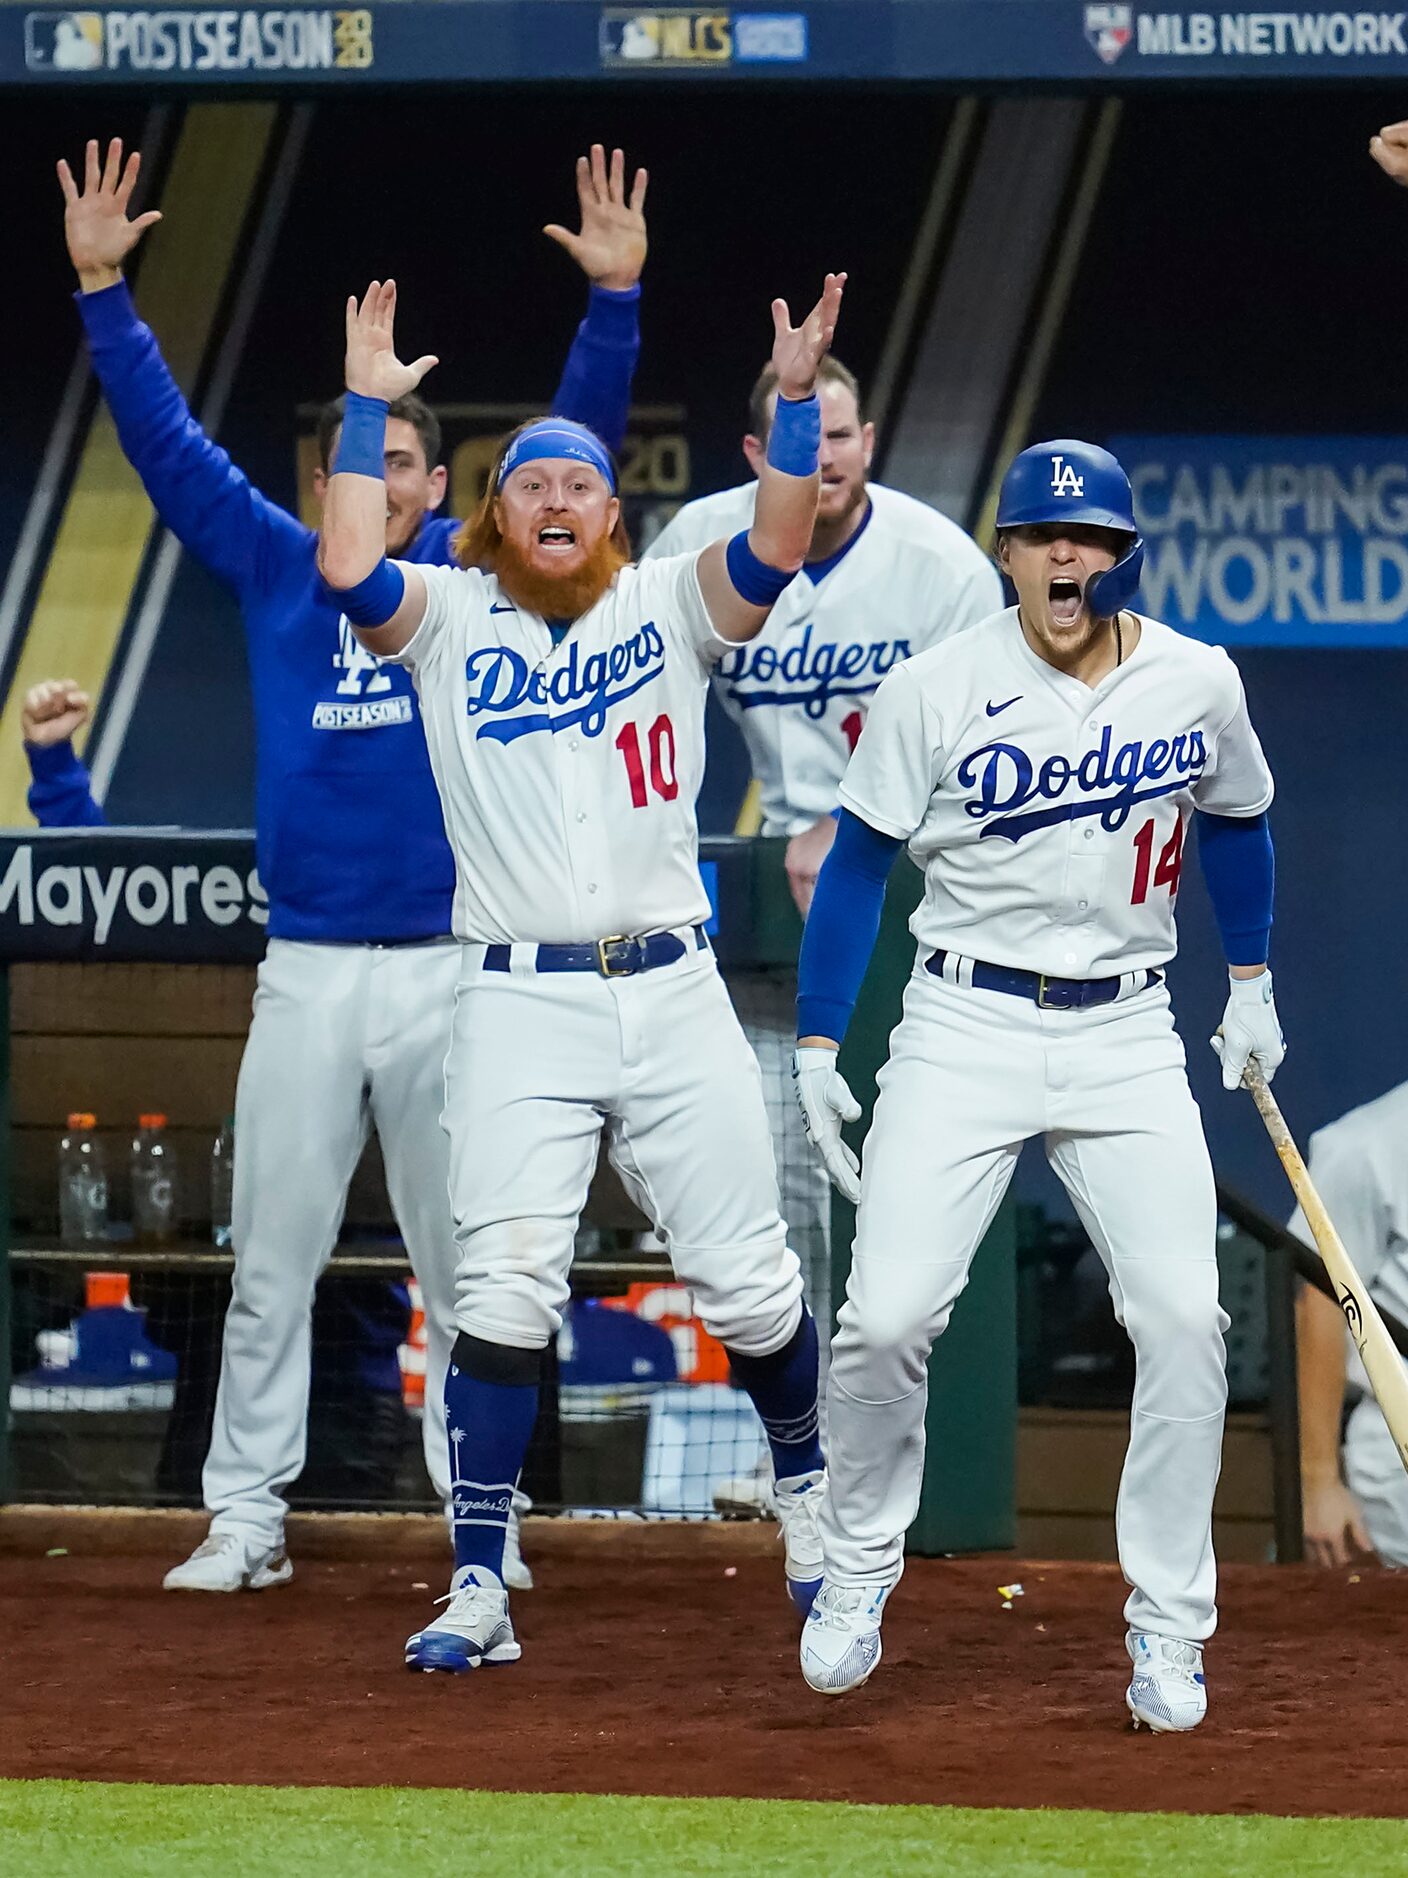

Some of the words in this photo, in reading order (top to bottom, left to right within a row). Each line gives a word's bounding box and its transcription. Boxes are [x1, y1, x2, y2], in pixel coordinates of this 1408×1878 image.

[106, 10, 333, 70] POSTSEASON
[1136, 13, 1216, 55] MLB
[1219, 12, 1408, 55] NETWORK
[1050, 456, 1085, 498] LA
[466, 621, 665, 740] Dodgers
[615, 713, 679, 809] 10
[957, 724, 1207, 834] Dodgers
[1130, 807, 1186, 905] 14
